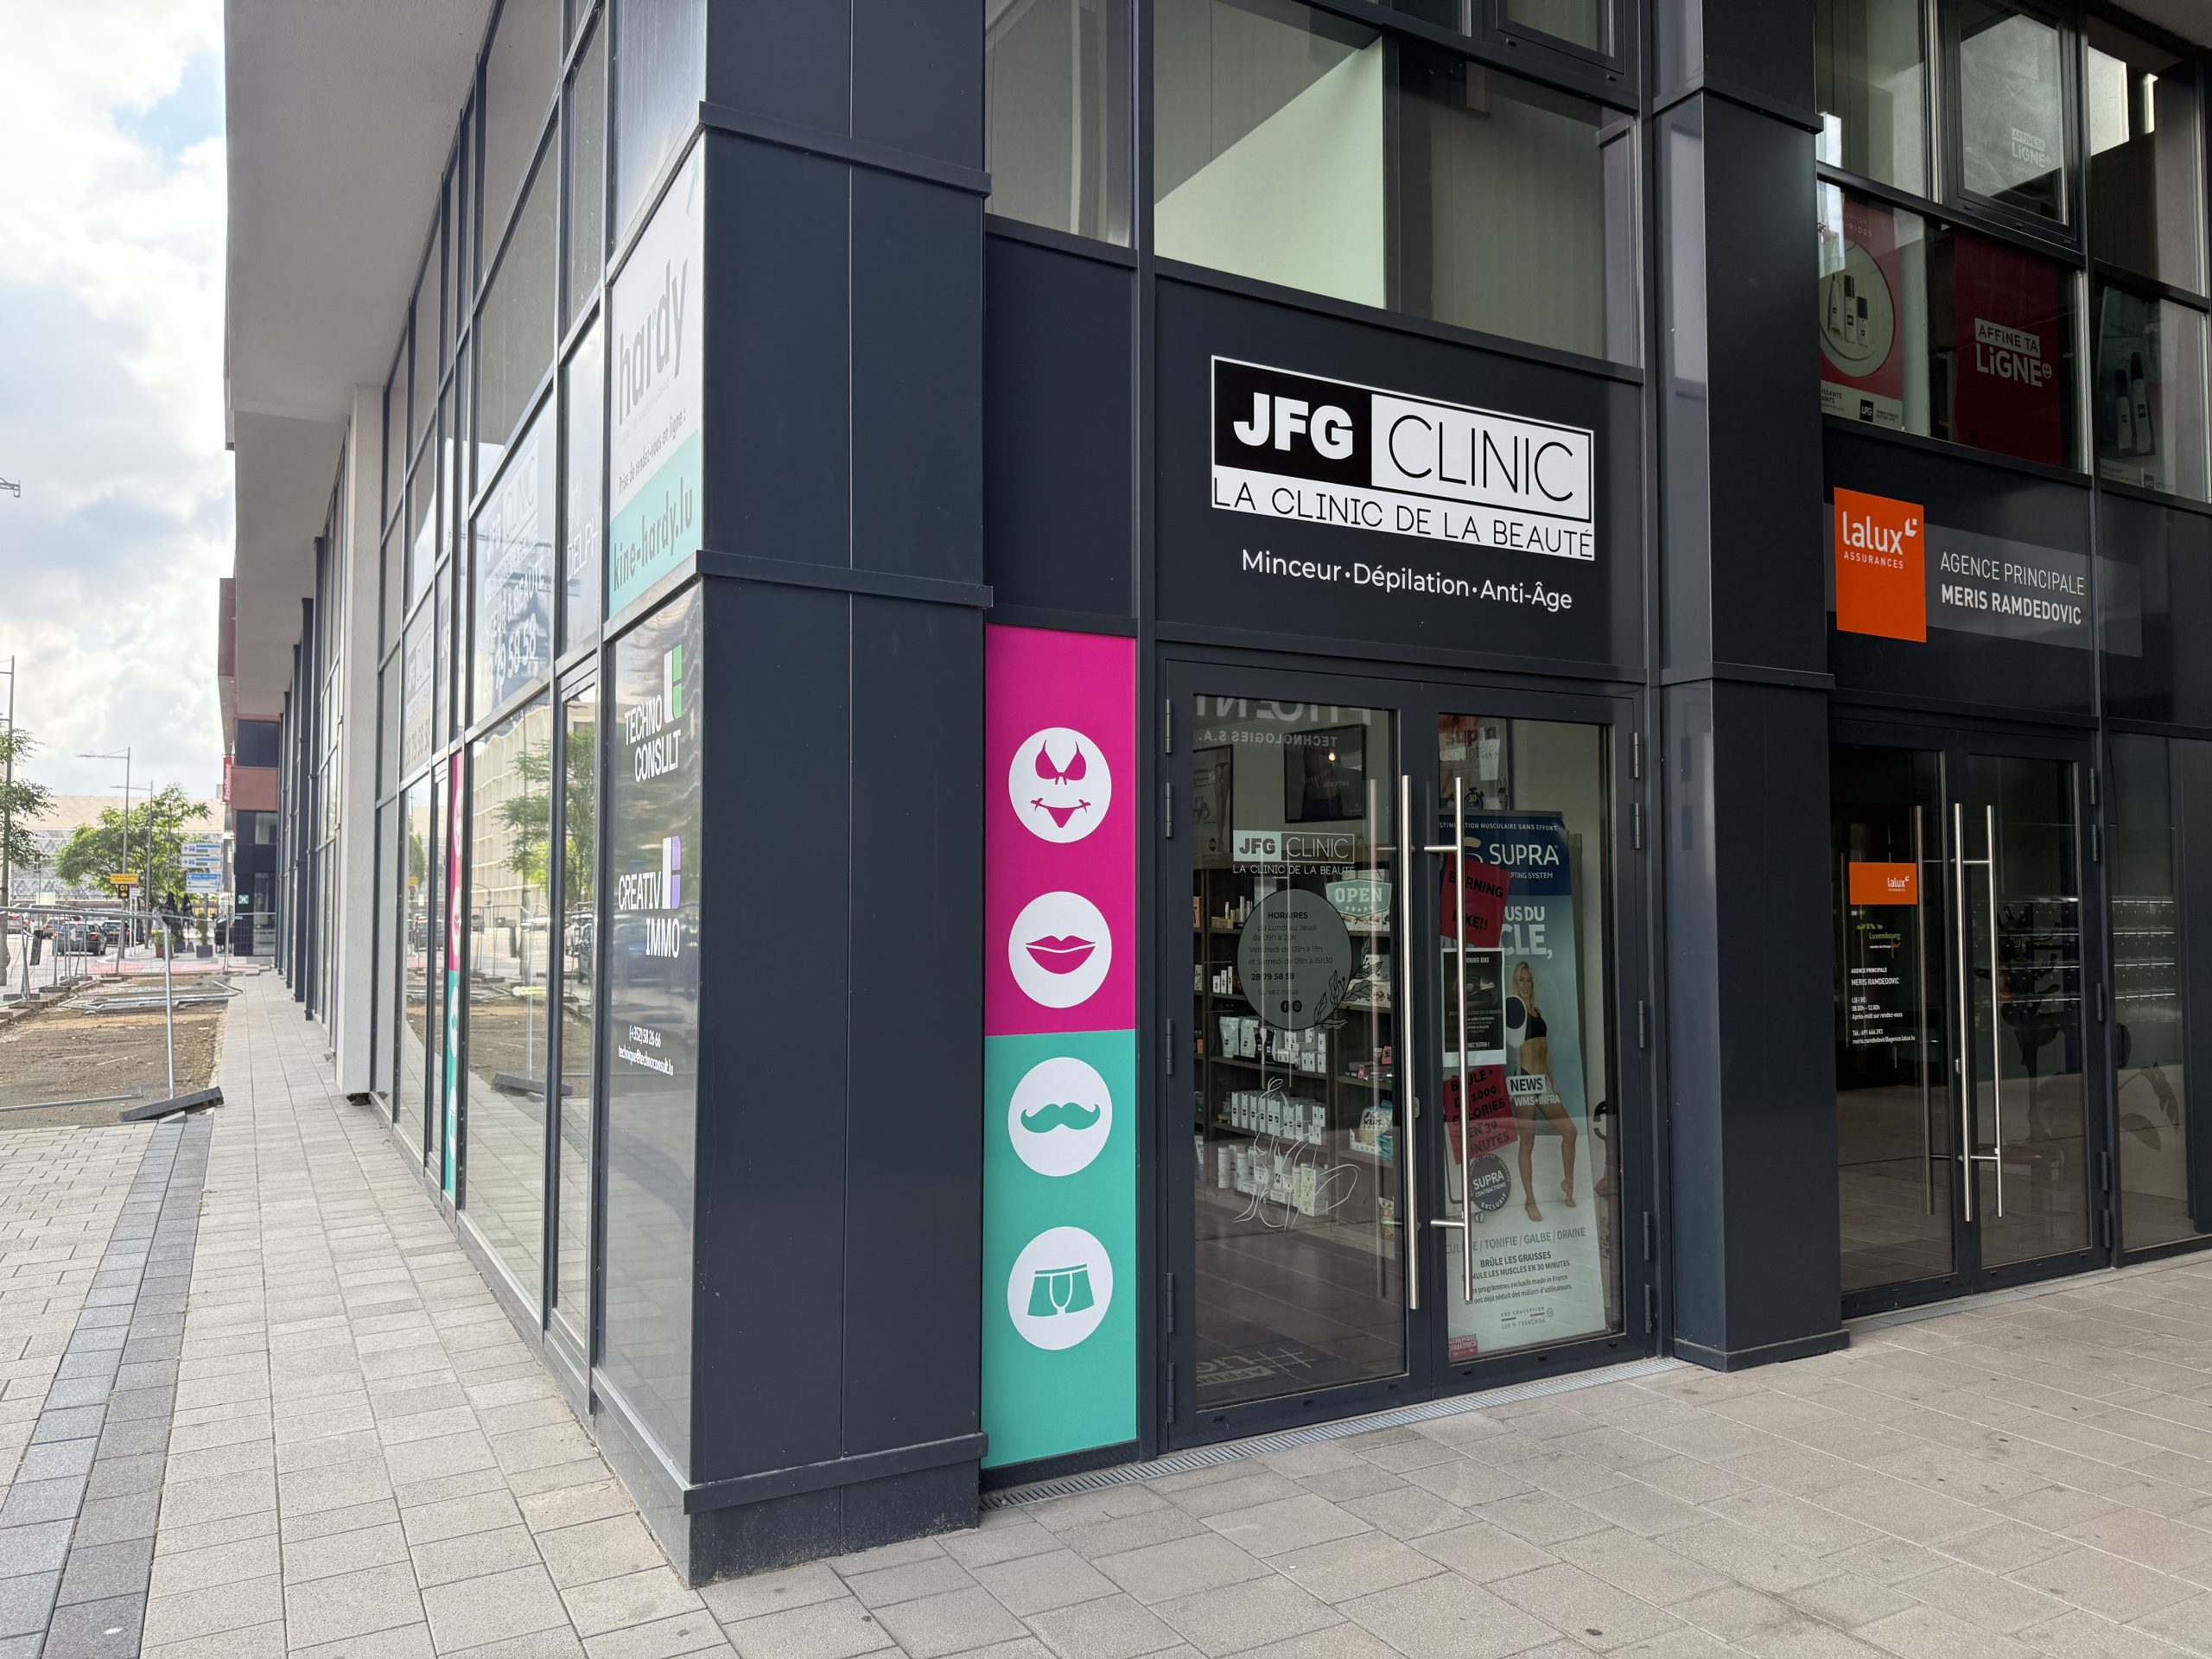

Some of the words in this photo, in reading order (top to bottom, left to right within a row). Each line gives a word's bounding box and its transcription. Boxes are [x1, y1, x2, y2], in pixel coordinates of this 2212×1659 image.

[619, 257, 688, 427] hardy
[1979, 324, 2022, 347] AFFINE
[2024, 337, 2038, 353] TA
[1976, 343, 2043, 387] LiGNE
[1861, 405, 1872, 416] LPG
[1233, 391, 1353, 460] JFG
[1389, 414, 1573, 502] CLINIC
[1213, 477, 1256, 512] LA
[1271, 487, 1383, 528] CLINIC
[1396, 505, 1433, 536] DE
[1444, 512, 1481, 543] LA
[1493, 520, 1593, 559] BEAUTÉ
[613, 475, 693, 592] kine-hardy.lu
[1842, 511, 1904, 555] lalux
[1843, 551, 1904, 569] ASSURANCES
[1242, 550, 1342, 582] Minceur
[1353, 563, 1470, 599] Dépilation
[1479, 581, 1573, 613] Anti-Âge
[1940, 551, 2000, 581] AGENCE
[2004, 563, 2085, 596] PRINCIPALE
[1942, 583, 1988, 610] MERIS
[1992, 595, 2082, 626] RAMDEDOVIC
[507, 633, 521, 678] 58
[522, 612, 537, 666] 58
[624, 694, 662, 747] TECHNO
[1468, 794, 1478, 803] 30
[1439, 822, 1478, 830] STIMTION
[1239, 838, 1276, 855] JFG
[1286, 836, 1349, 859] CLINIC
[1489, 843, 1560, 866] SUPRA
[1233, 864, 1247, 874] LA
[1249, 864, 1286, 874] CLINIC
[1289, 865, 1301, 874] DE
[1304, 866, 1317, 874] LA
[1320, 866, 1355, 876] BEAUTÉ
[617, 871, 662, 911] CREATIV
[1447, 871, 1504, 899] BRNING
[1887, 877, 1906, 888] lalux
[1334, 887, 1382, 903] OPEN
[1452, 910, 1489, 931] BKE!!
[1524, 906, 1545, 922] DU
[645, 918, 681, 958] IMMO
[1471, 1085, 1497, 1102] 1000
[1510, 1077, 1543, 1092] NEWS
[1514, 1095, 1560, 1107] WMS+INFRA
[1452, 1098, 1506, 1126] CLORIES
[1484, 1121, 1497, 1135] 30
[1472, 1170, 1505, 1191] SUPRA
[1475, 1181, 1507, 1198] CONTRACTIONS
[1480, 1192, 1507, 1211] EXCLUSIF
[1485, 1236, 1517, 1249] TONIFIE
[1524, 1232, 1551, 1245] GALBE
[1557, 1227, 1586, 1241] DRAINE
[1480, 1255, 1503, 1268] BRÛLE
[1504, 1255, 1517, 1266] LES
[1518, 1251, 1552, 1264] GRAISSES
[1500, 1267, 1528, 1277] MUSCLES
[1545, 1260, 1570, 1270] MINUTES
[1478, 1283, 1510, 1295] programmes
[1510, 1279, 1531, 1290] exclusifs
[1532, 1277, 1546, 1286] made
[1552, 1274, 1568, 1283] France
[1496, 1293, 1511, 1301] séduit
[1511, 1290, 1521, 1299] des
[1521, 1287, 1539, 1296] milliers
